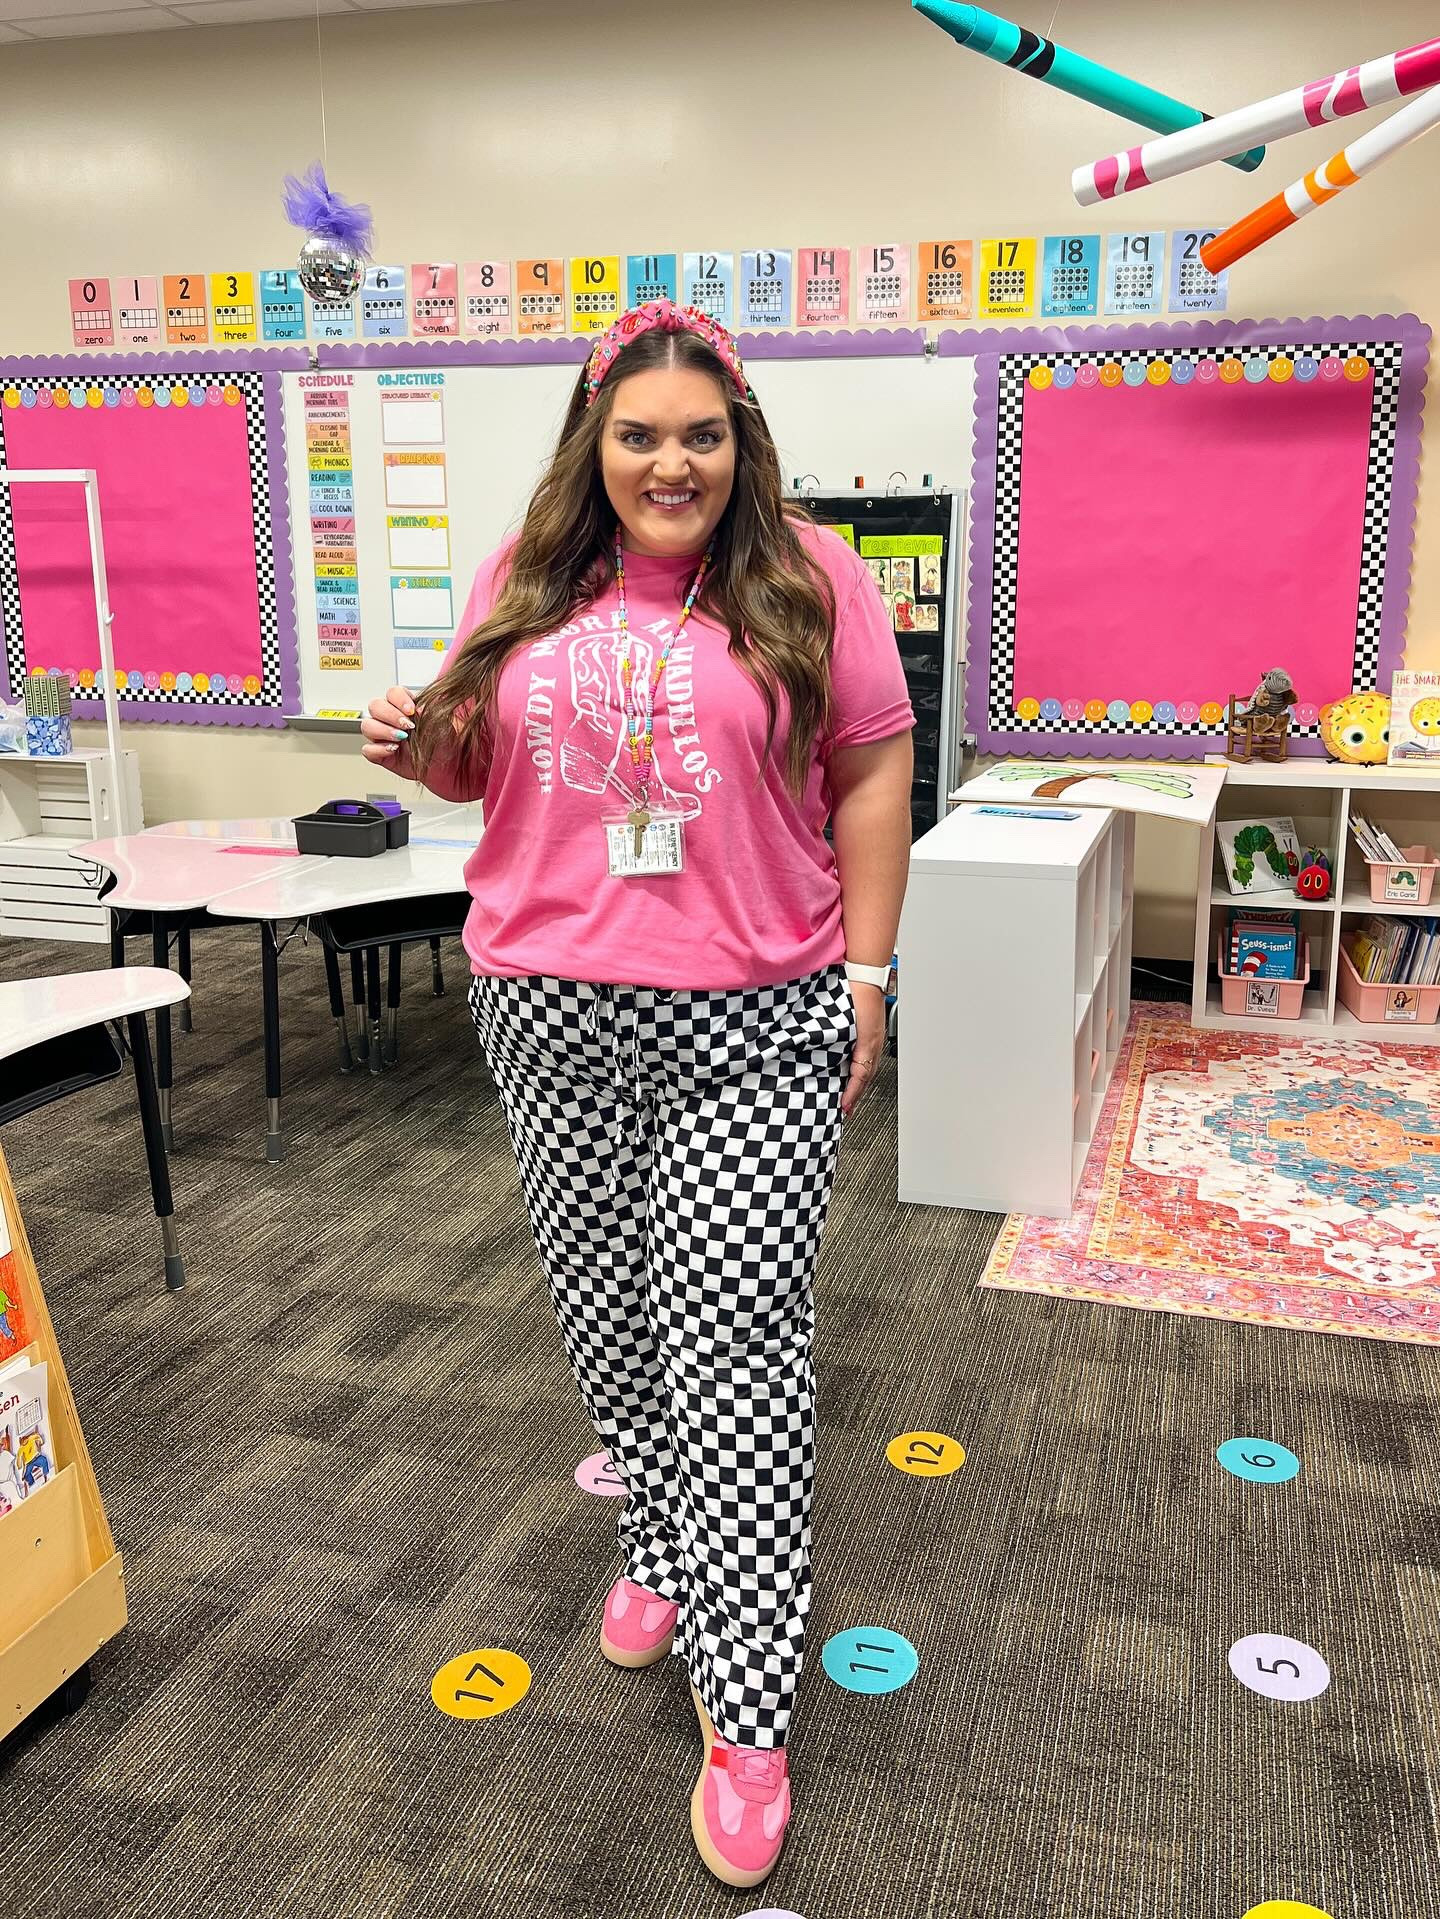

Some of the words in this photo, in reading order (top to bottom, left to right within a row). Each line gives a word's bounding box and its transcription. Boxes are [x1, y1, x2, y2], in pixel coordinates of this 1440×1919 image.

[997, 241, 1020, 267] 17
[1061, 239, 1084, 264] 18
[1123, 236, 1150, 262] 19
[873, 248, 894, 273] 15
[934, 244, 957, 270] 16
[645, 257, 659, 281] 11
[699, 255, 718, 279] 12
[756, 252, 776, 277] 13
[813, 251, 835, 276] 14
[428, 266, 441, 289] 7
[481, 264, 494, 288] 8
[532, 262, 549, 286] 9
[585, 260, 606, 284] 10
[275, 272, 289, 294] 4
[376, 268, 389, 289] 6
[82, 282, 97, 303] 0
[133, 279, 139, 301] 1
[178, 278, 191, 300] 2
[226, 275, 238, 298] 3
[1052, 304, 1087, 314] eighteen
[1115, 302, 1151, 310] nineteen
[1183, 298, 1213, 308] twenty
[749, 313, 782, 323] thirteen
[806, 313, 840, 322] fourteen
[869, 309, 898, 320] fifteen
[929, 307, 959, 317] sixteen
[378, 324, 391, 334] six
[423, 324, 450, 333] seven
[477, 321, 500, 333] eight
[532, 320, 553, 330] nine
[589, 320, 604, 329] ten
[179, 332, 196, 342] two
[223, 330, 248, 340] three
[274, 328, 294, 338] four
[325, 326, 343, 337] five
[84, 336, 104, 345] zero
[132, 334, 149, 343] one
[298, 375, 354, 387] SCHEDULE
[377, 373, 445, 386] OBJECTIVES
[311, 473, 336, 482] READING
[335, 505, 353, 513] DOWN
[313, 520, 338, 529] WRITING
[391, 516, 429, 527] WRITING
[862, 538, 894, 555] Yes,
[333, 597, 357, 606] SCIENCE
[319, 612, 336, 621] MATH
[333, 627, 358, 636] PACK-UP
[332, 658, 360, 666] DISMISSAL
[1396, 674, 1410, 684] THE
[1414, 674, 1440, 686] SMART
[524, 672, 558, 794] HOWDY
[1241, 938, 1292, 952] Seuss-isms!
[904, 1440, 946, 1467] 12
[1240, 1452, 1276, 1468] 6
[849, 1642, 895, 1674] 11
[1256, 1656, 1300, 1678] 5
[456, 1662, 505, 1703] 17
